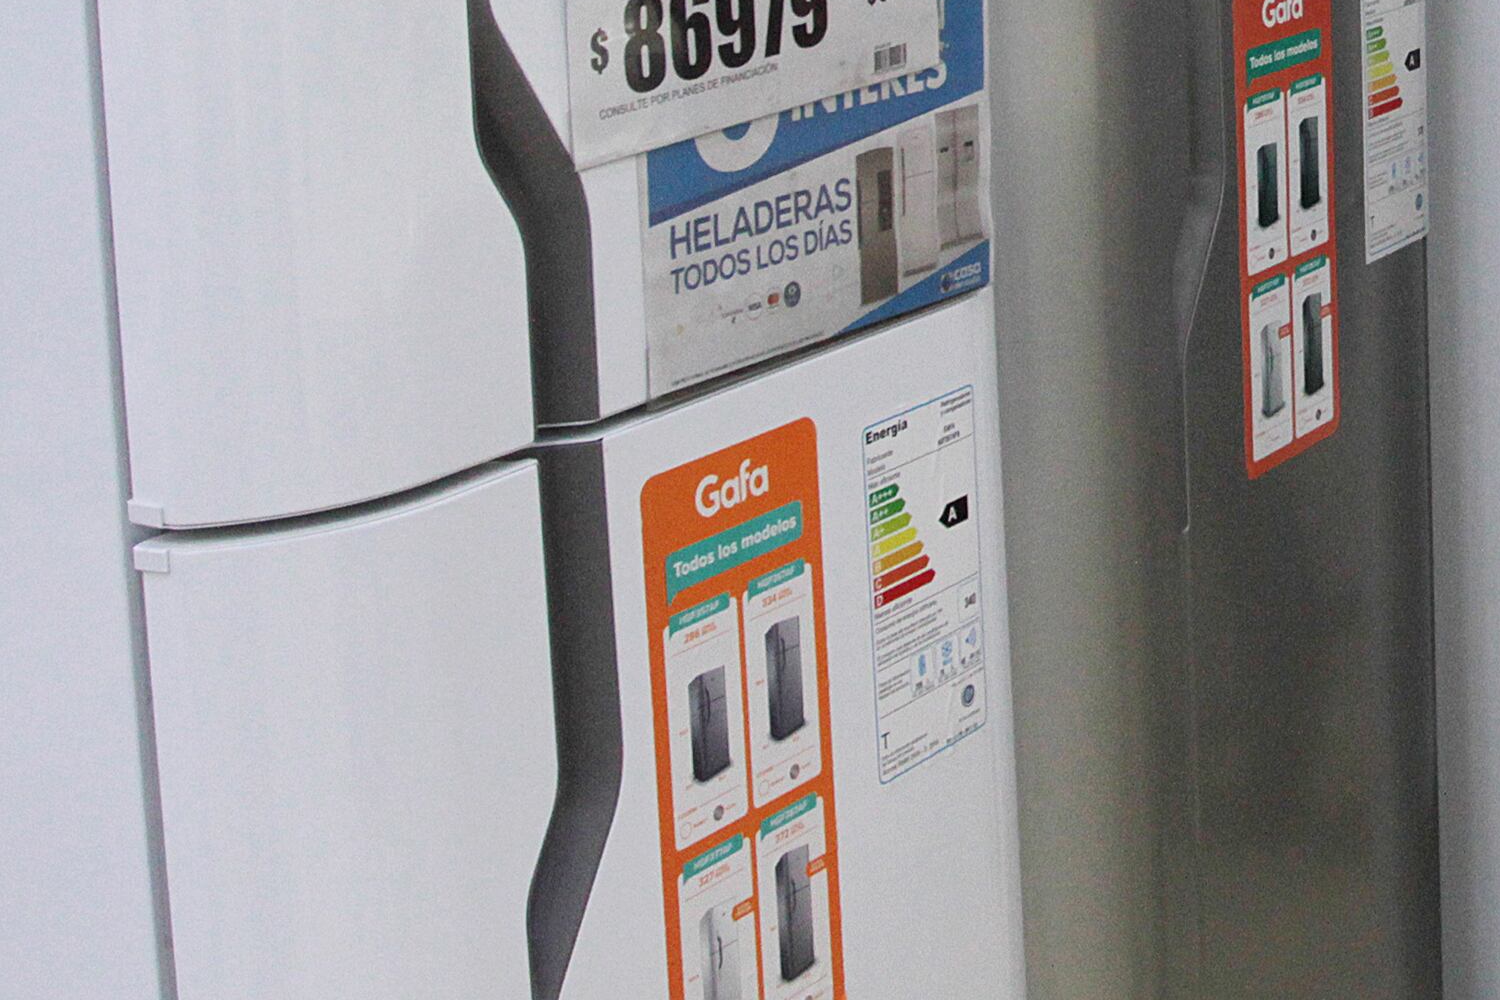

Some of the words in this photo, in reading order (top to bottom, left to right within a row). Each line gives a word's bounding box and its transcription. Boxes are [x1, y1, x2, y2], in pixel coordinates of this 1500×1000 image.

[590, 27, 610, 75] $
[1249, 52, 1273, 69] Todos
[1274, 48, 1285, 63] los
[1286, 38, 1318, 58] modelos
[1408, 55, 1416, 66] A
[599, 97, 649, 121] CONSULTE
[650, 91, 671, 106] POR
[671, 80, 707, 101] PLANES
[707, 77, 721, 90] DE
[669, 177, 852, 260] HELADERAS
[670, 248, 751, 294] TODOS
[756, 234, 799, 270] LOS
[804, 218, 852, 257] DÍAS
[866, 418, 907, 444] Energía
[695, 458, 769, 518] Gafa
[872, 490, 893, 504] A+++
[872, 507, 889, 522] A++
[948, 506, 957, 522] A
[873, 526, 885, 539] A+
[673, 554, 714, 578] Todos
[718, 541, 738, 560] los
[741, 516, 797, 549] modelos
[875, 577, 883, 590] C
[876, 595, 885, 608] D
[881, 732, 890, 749] T
